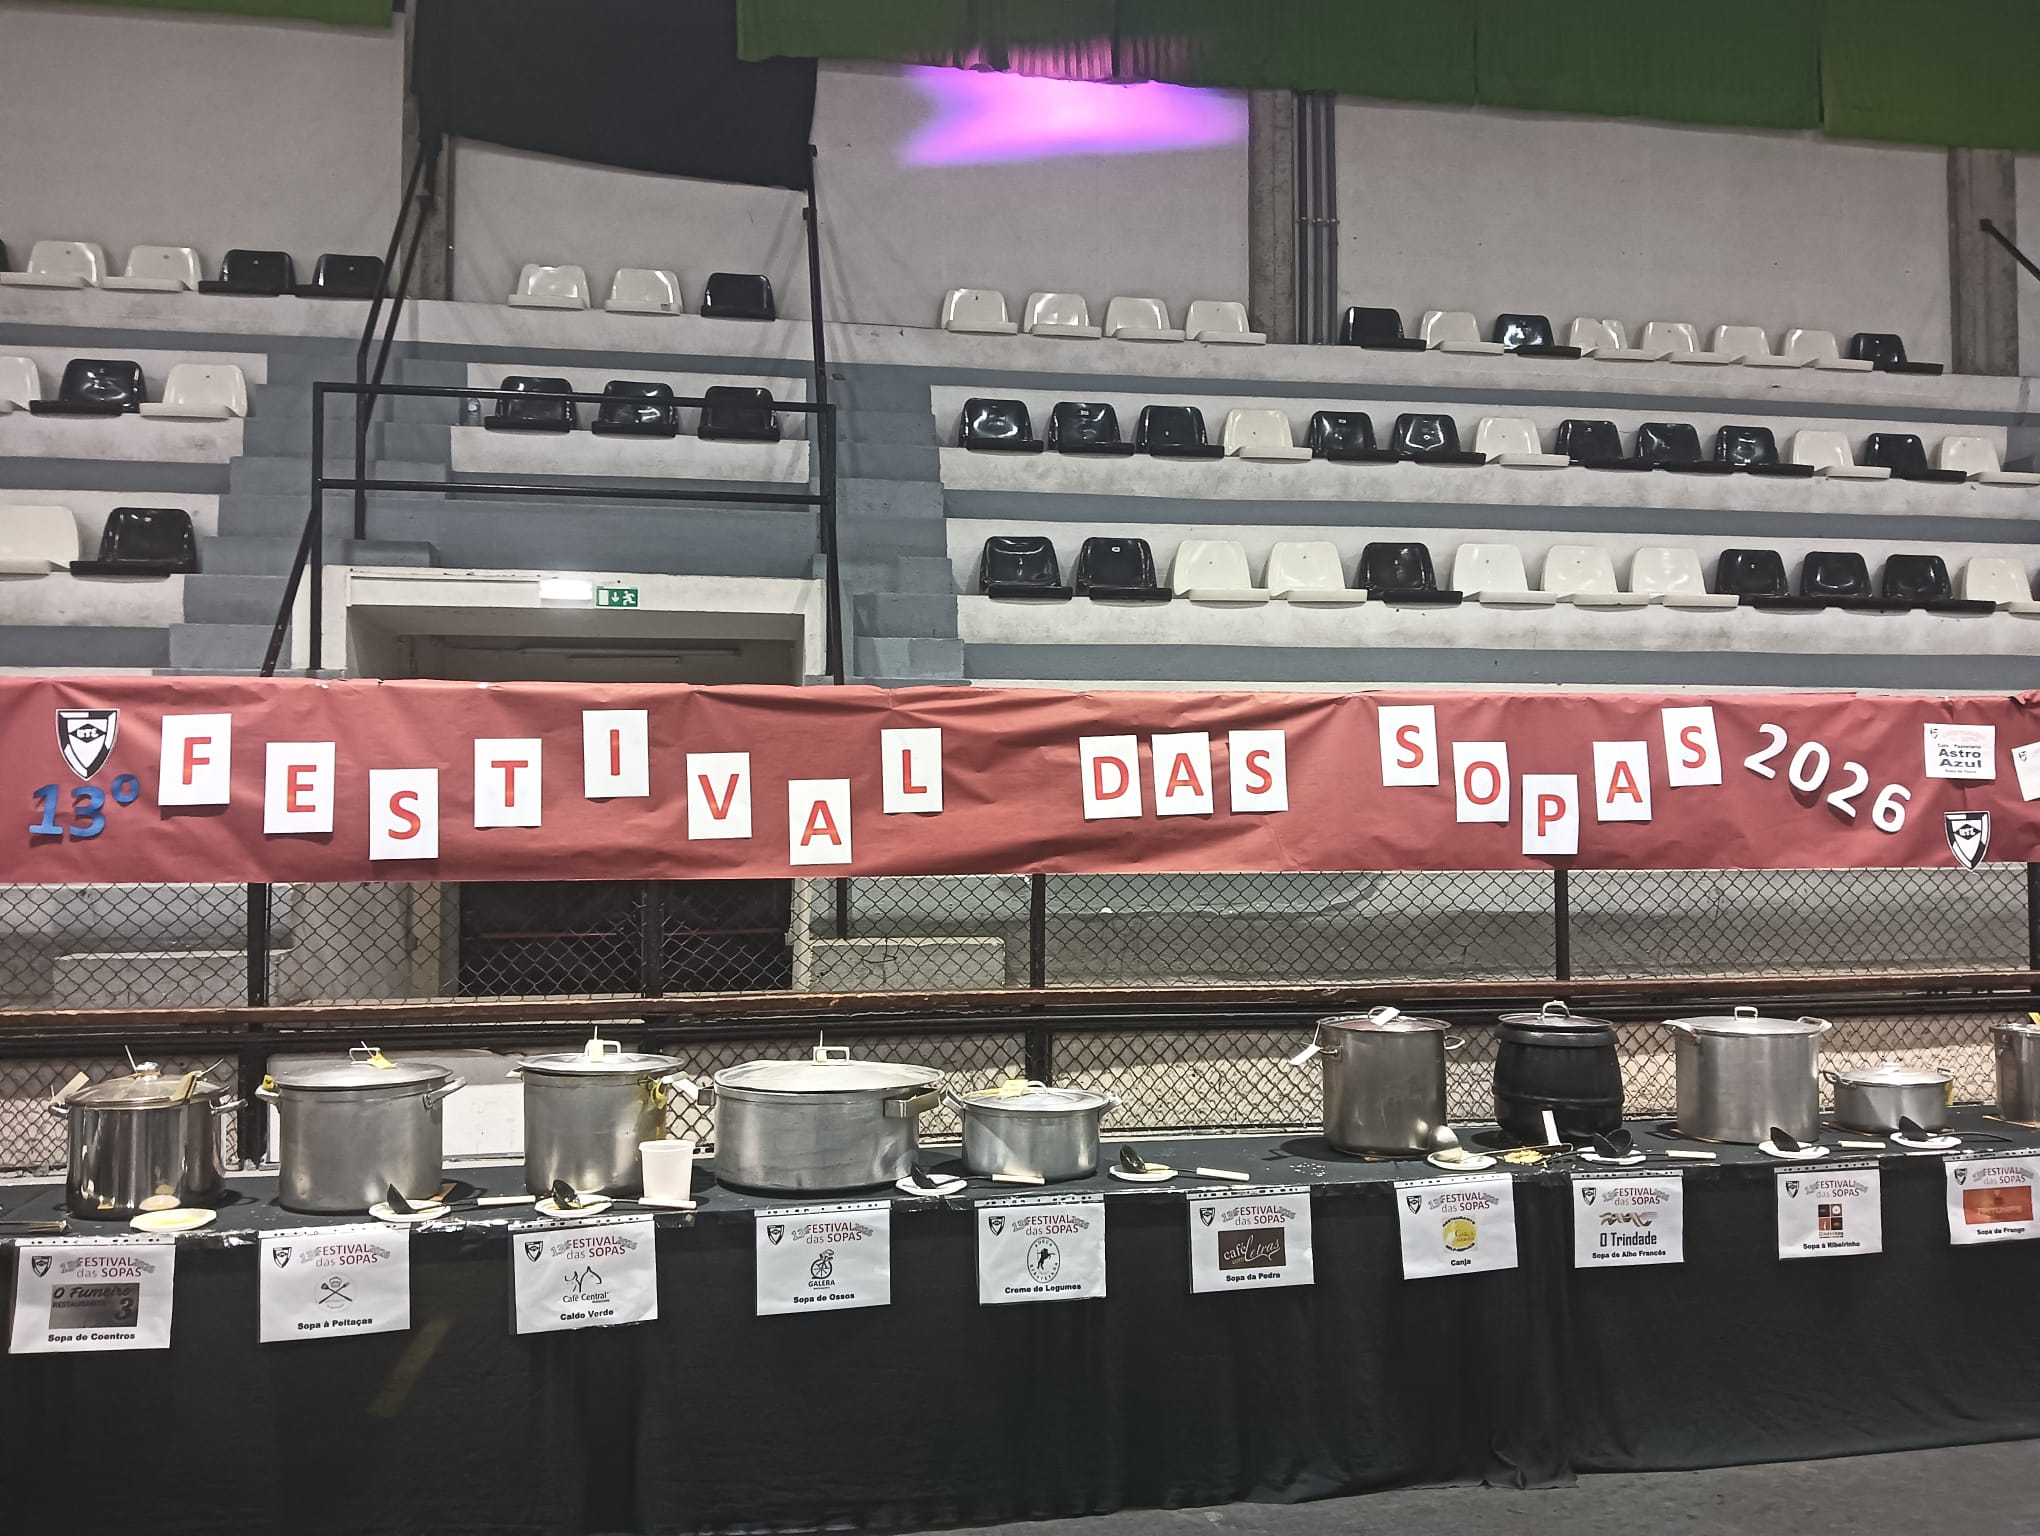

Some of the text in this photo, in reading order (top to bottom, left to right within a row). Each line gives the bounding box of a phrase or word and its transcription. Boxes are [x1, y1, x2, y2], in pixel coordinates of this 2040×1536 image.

[1938, 748, 1981, 758] Astro
[1939, 759, 1982, 768] Azul
[29, 723, 1912, 846] 13º FESTIVAL DAS SOPAS 2026
[1982, 1167, 2021, 1176] FESTIVAL
[1816, 1180, 1853, 1189] FESTIVAL
[1999, 1175, 2026, 1184] SOPAS
[1440, 1191, 1484, 1203] FESTIVAL
[1614, 1187, 1654, 1197] FESTIVAL
[1832, 1188, 1860, 1198] SOPAS
[1614, 1195, 1660, 1206] das SOPAS
[1235, 1205, 1280, 1216] FESTIVAL
[1441, 1200, 1490, 1213] das SOPAS
[1025, 1214, 1072, 1226] FESTIVAL
[1235, 1214, 1286, 1226] das SOPAS
[806, 1222, 855, 1234] FESTIVAL
[1025, 1224, 1079, 1236] das SOPAS
[566, 1235, 618, 1249] FESTIVAL
[806, 1232, 862, 1244] das SOPAS
[1600, 1231, 1657, 1247] O Trindade
[316, 1243, 370, 1256] FESTIVAL
[566, 1245, 626, 1260] das SOPAS
[1223, 1242, 1247, 1260] café
[1592, 1249, 1666, 1260] Sopa de Alho Francês
[78, 1256, 135, 1267] FESTIVAL
[316, 1253, 379, 1267] das SOPAS
[1450, 1258, 1472, 1267] Canja
[77, 1267, 142, 1278] das SOPAS
[1226, 1275, 1245, 1283] Sopa
[1258, 1272, 1281, 1280] Pedra
[808, 1279, 835, 1288] GALERA
[1004, 1286, 1031, 1294] Creme
[1045, 1283, 1082, 1294] Legumes
[54, 1286, 131, 1299] O Fumeiro
[562, 1292, 609, 1303] Café Central
[793, 1293, 855, 1305] Sopa de Ossos
[115, 1298, 133, 1321] 3
[560, 1309, 614, 1321] Caldo Verde
[297, 1322, 321, 1331] Sopa
[48, 1332, 135, 1343] Sopa de Coentros
